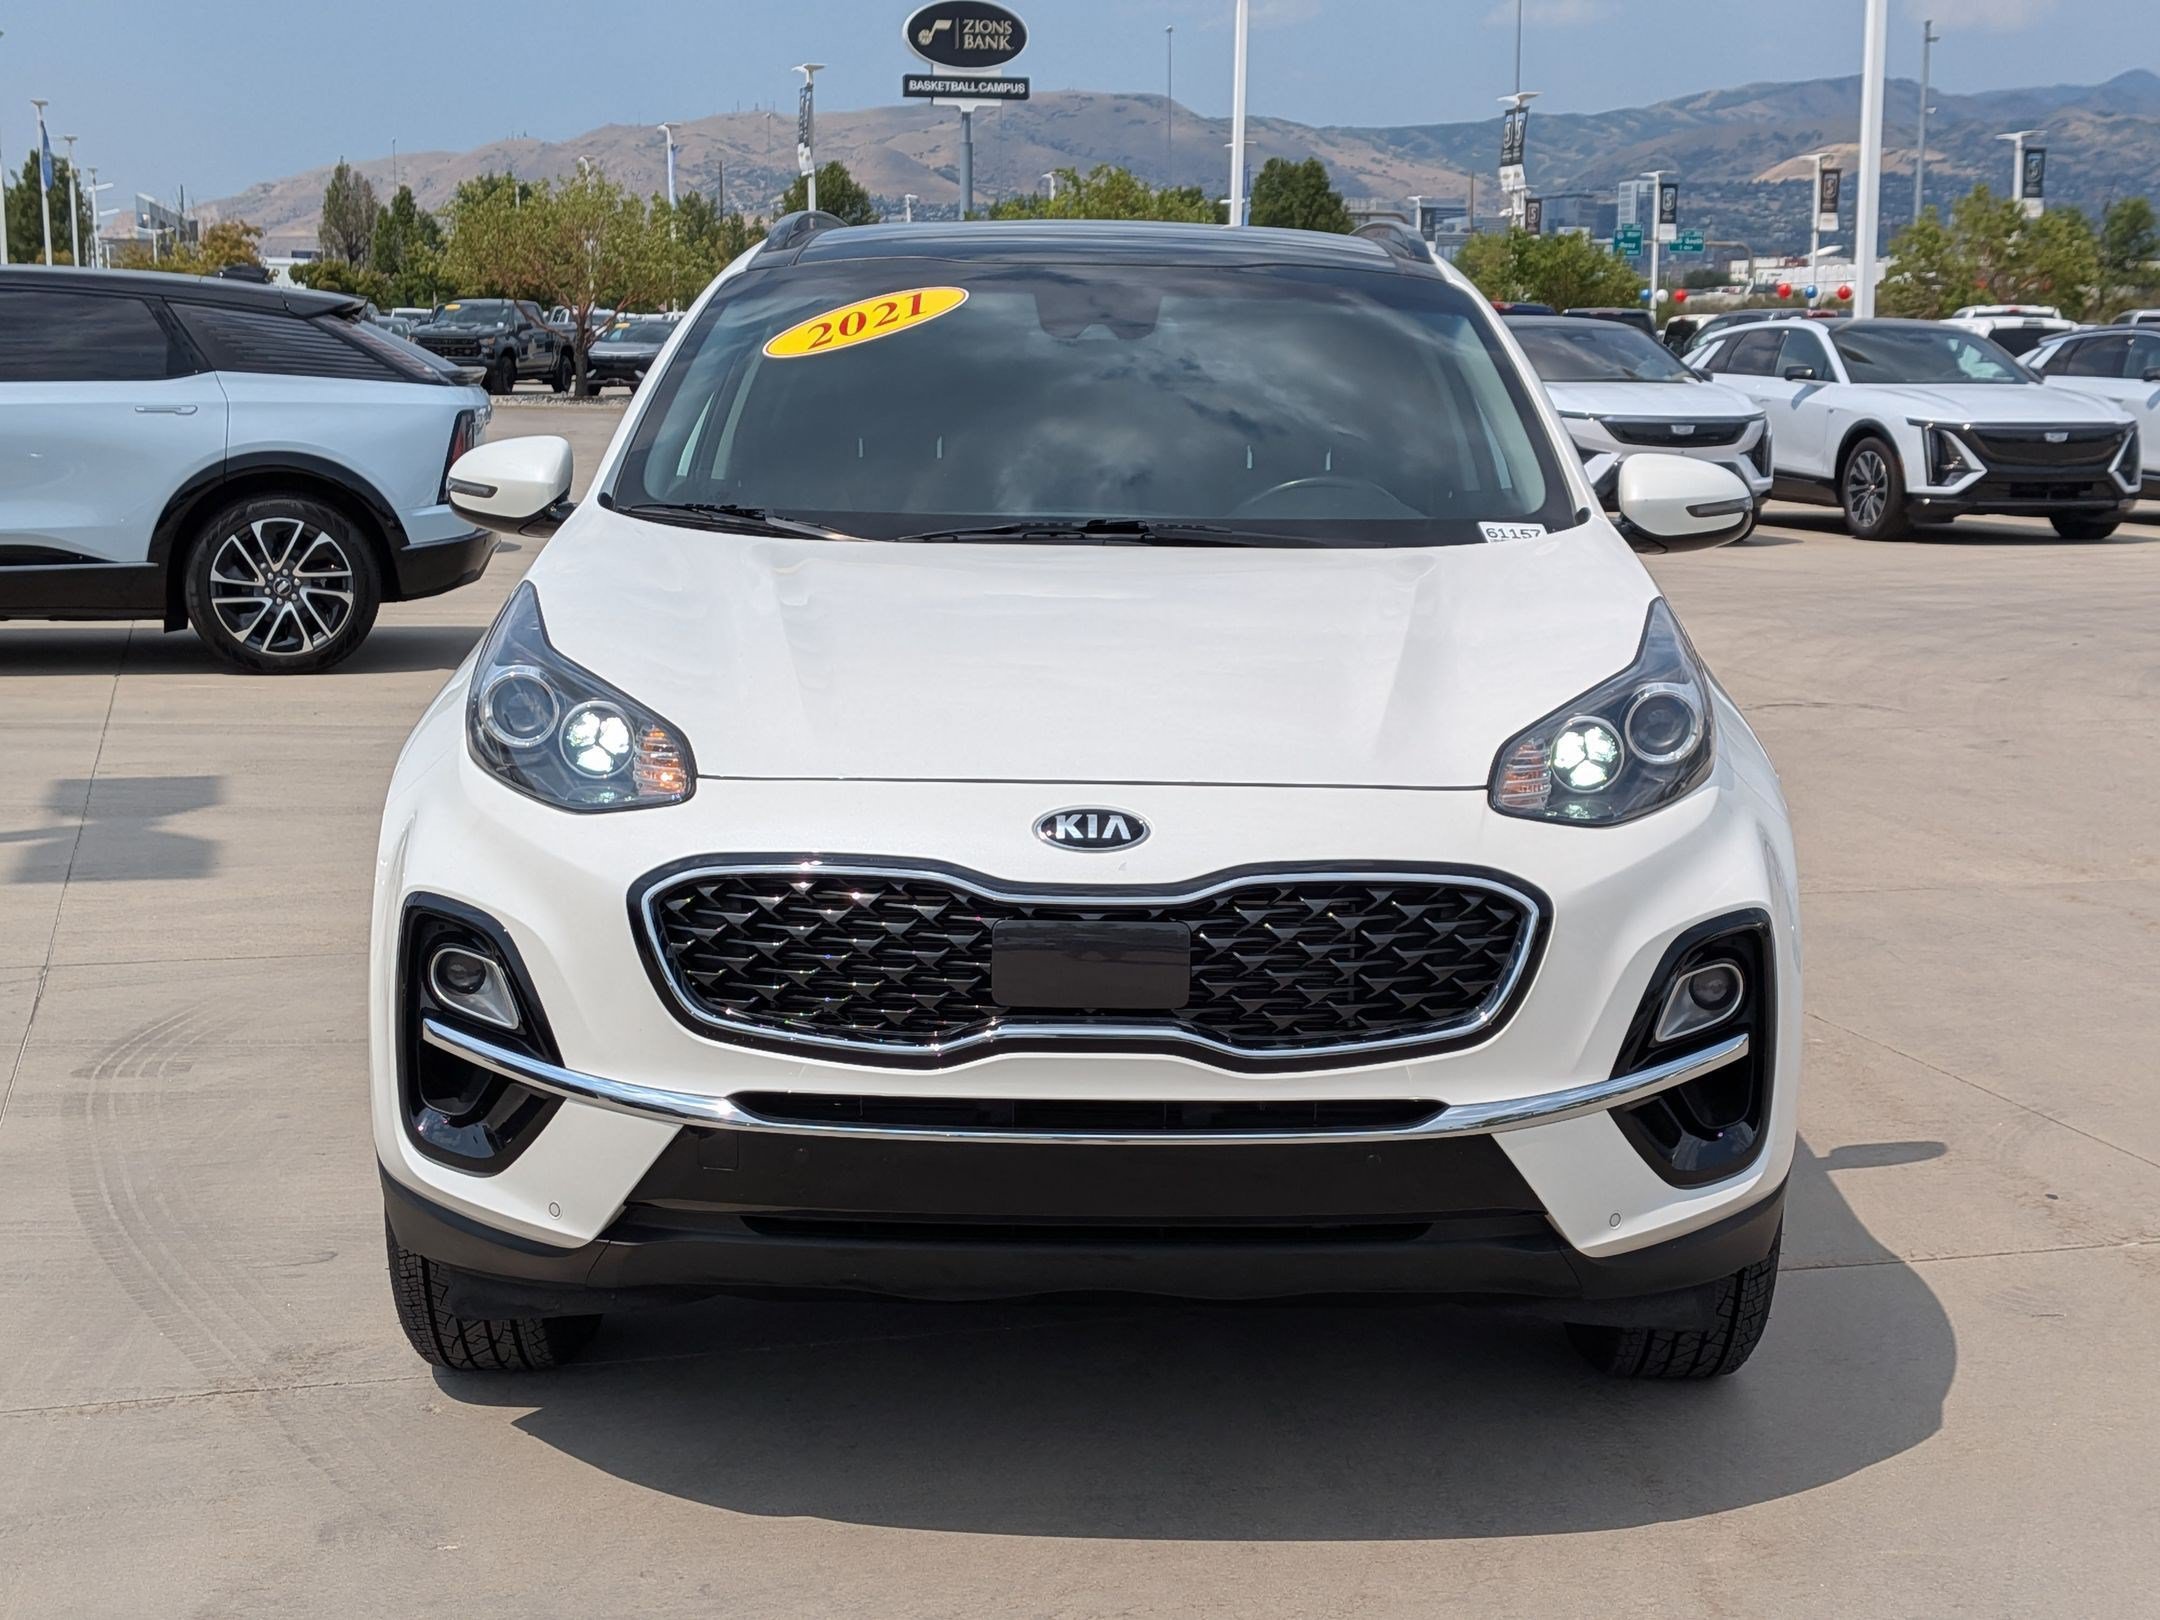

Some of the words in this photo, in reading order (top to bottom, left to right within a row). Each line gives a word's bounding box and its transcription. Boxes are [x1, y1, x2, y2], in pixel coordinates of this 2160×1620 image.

[962, 19, 1013, 34] ZIONS
[963, 34, 1013, 50] BANK
[908, 79, 978, 93] BASKETBALL
[979, 81, 1026, 94] CAMPUS
[807, 292, 927, 350] 2021
[1486, 527, 1541, 539] 61157
[1055, 813, 1132, 840] KIA
